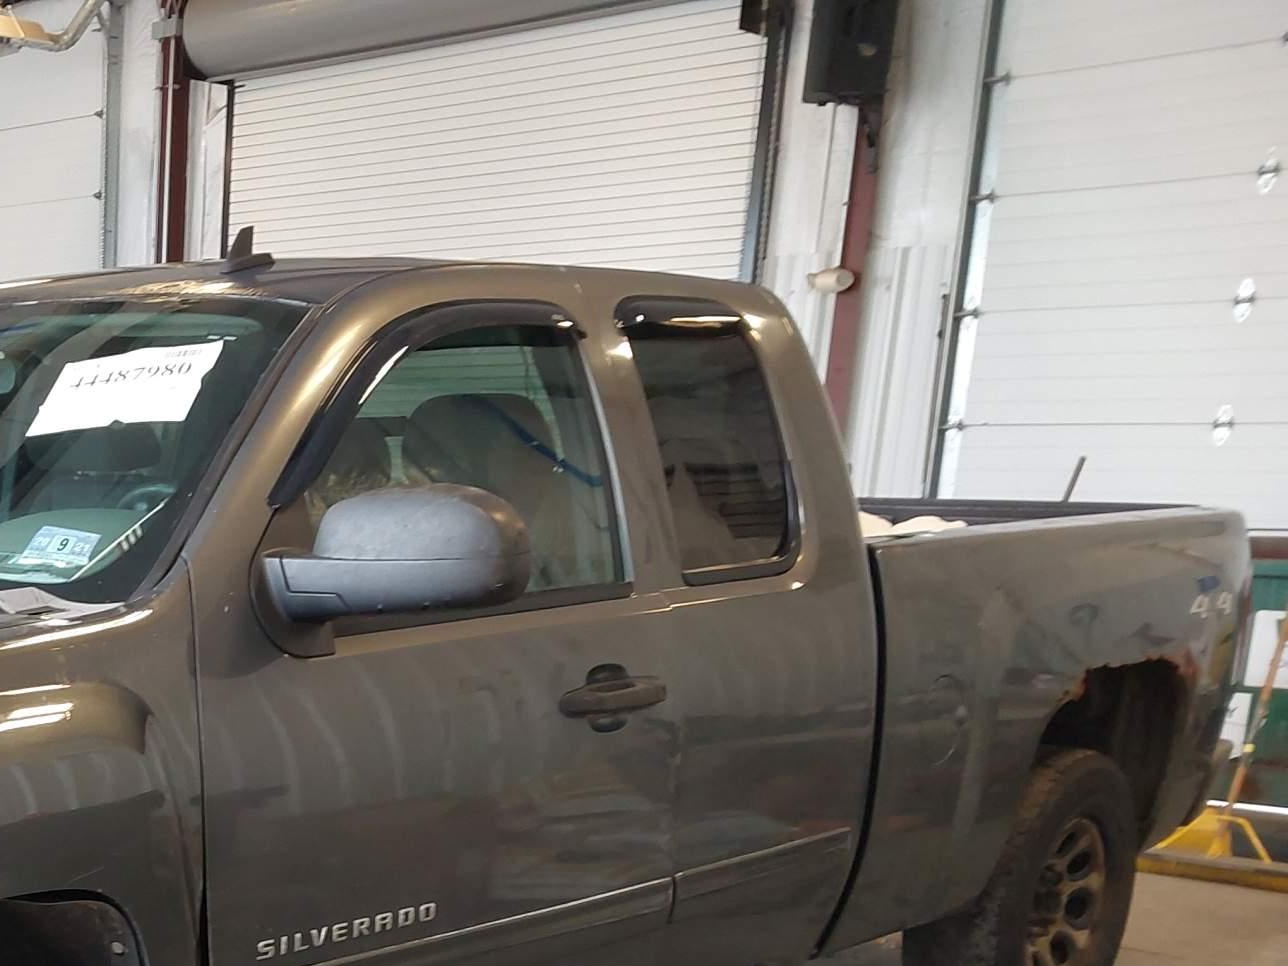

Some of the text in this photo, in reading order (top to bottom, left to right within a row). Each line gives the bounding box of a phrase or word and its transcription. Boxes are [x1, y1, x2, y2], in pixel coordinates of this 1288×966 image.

[69, 361, 193, 389] 44487980
[56, 537, 70, 552] 9
[255, 901, 438, 961] SILVERADO
